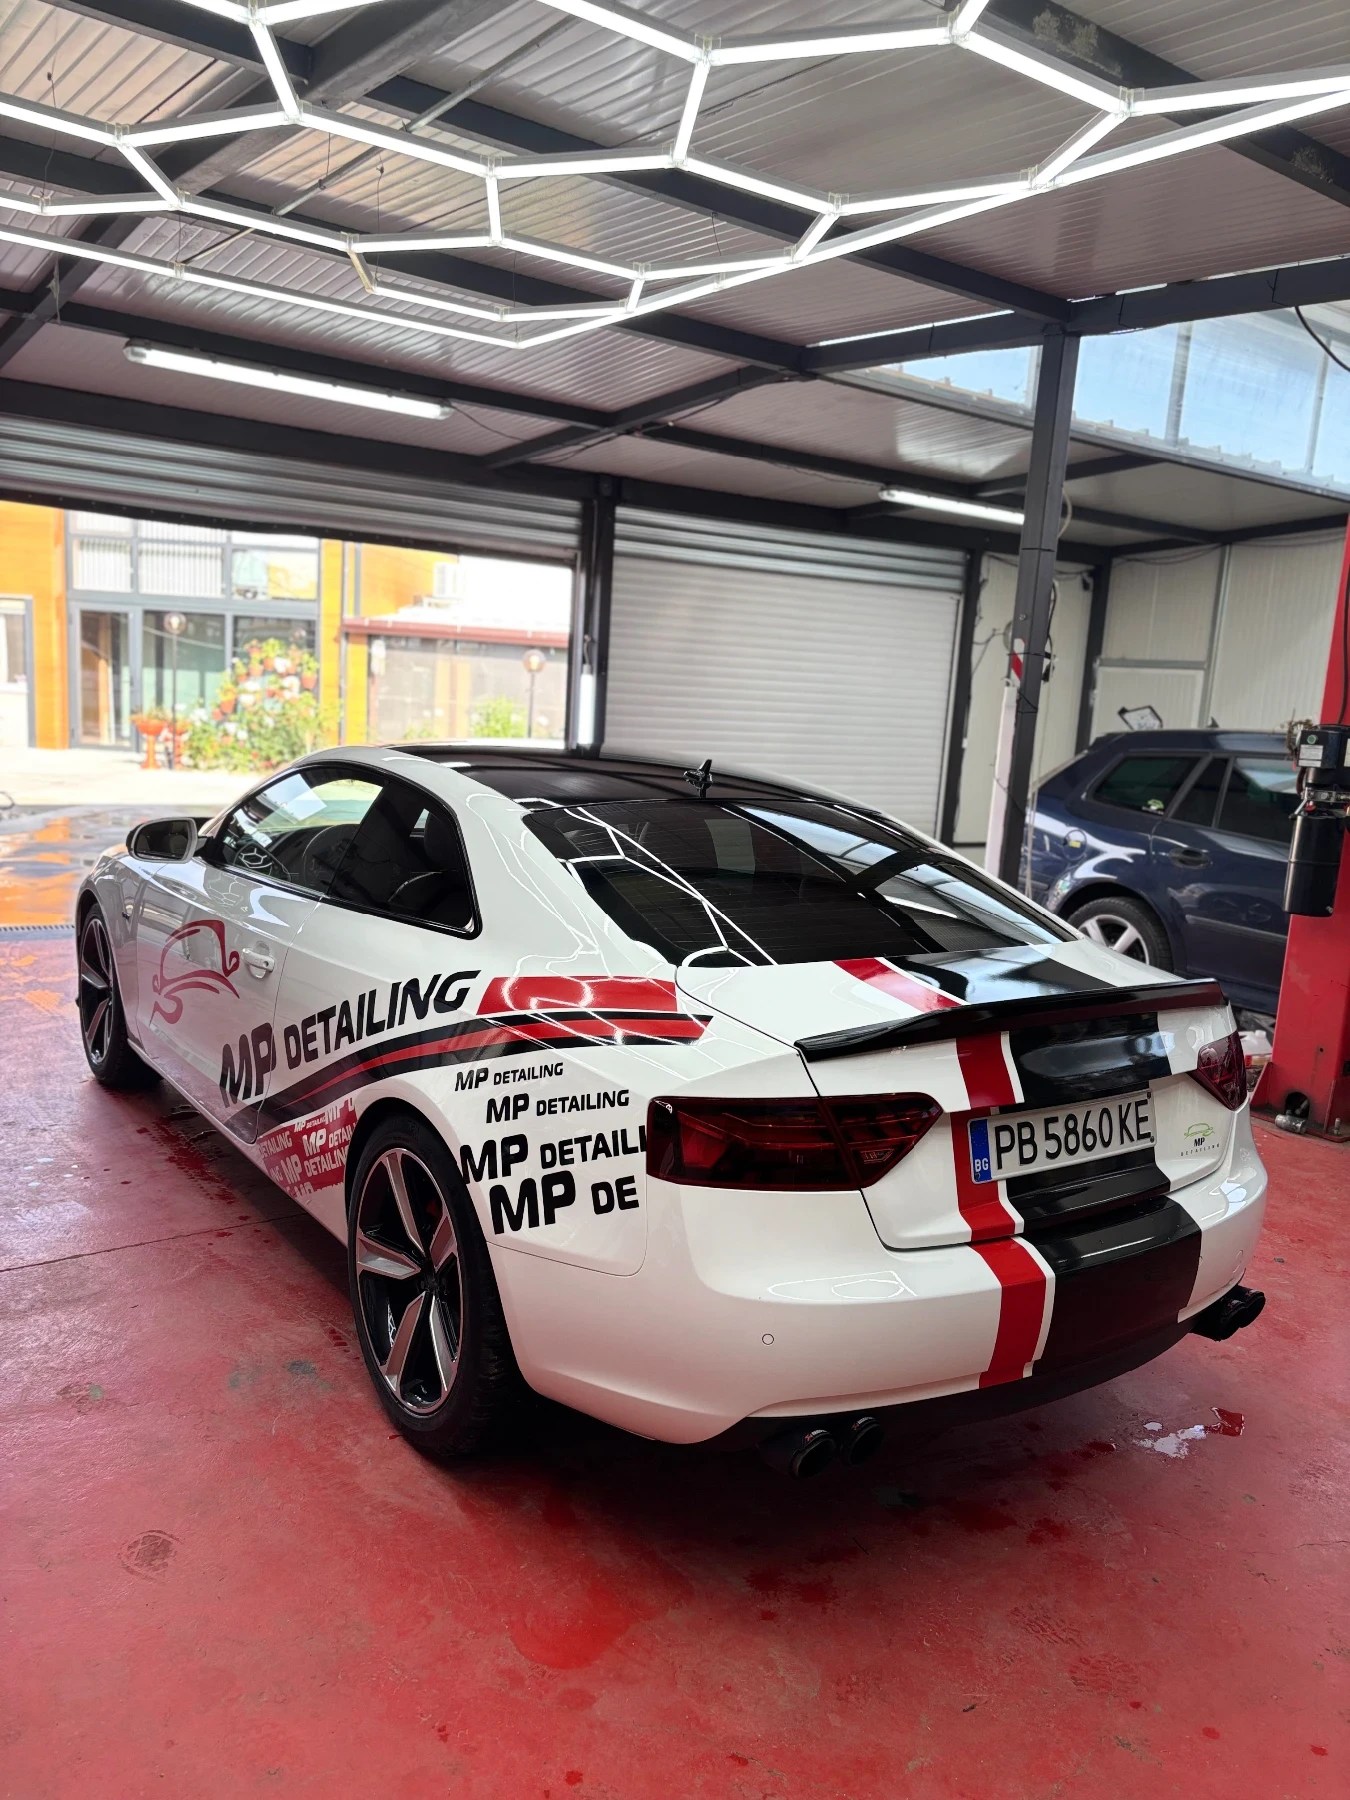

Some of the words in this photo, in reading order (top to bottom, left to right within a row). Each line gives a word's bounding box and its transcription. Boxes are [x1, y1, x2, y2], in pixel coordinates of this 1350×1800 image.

[219, 1022, 276, 1108] MP
[284, 970, 481, 1070] DETAILING
[455, 1067, 489, 1091] MP
[494, 1062, 564, 1085] DETAILING
[486, 1093, 529, 1123] MP
[536, 1089, 630, 1116] DETAILING
[302, 1128, 327, 1156] MP
[994, 1121, 1037, 1170] PB
[1044, 1107, 1113, 1160] 5860
[1118, 1099, 1153, 1145] KE
[1194, 1137, 1205, 1147] MP
[281, 1154, 302, 1184] MP
[460, 1134, 528, 1184] MP
[974, 1157, 989, 1172] BG
[489, 1170, 576, 1235] MP
[591, 1175, 640, 1215] DE
